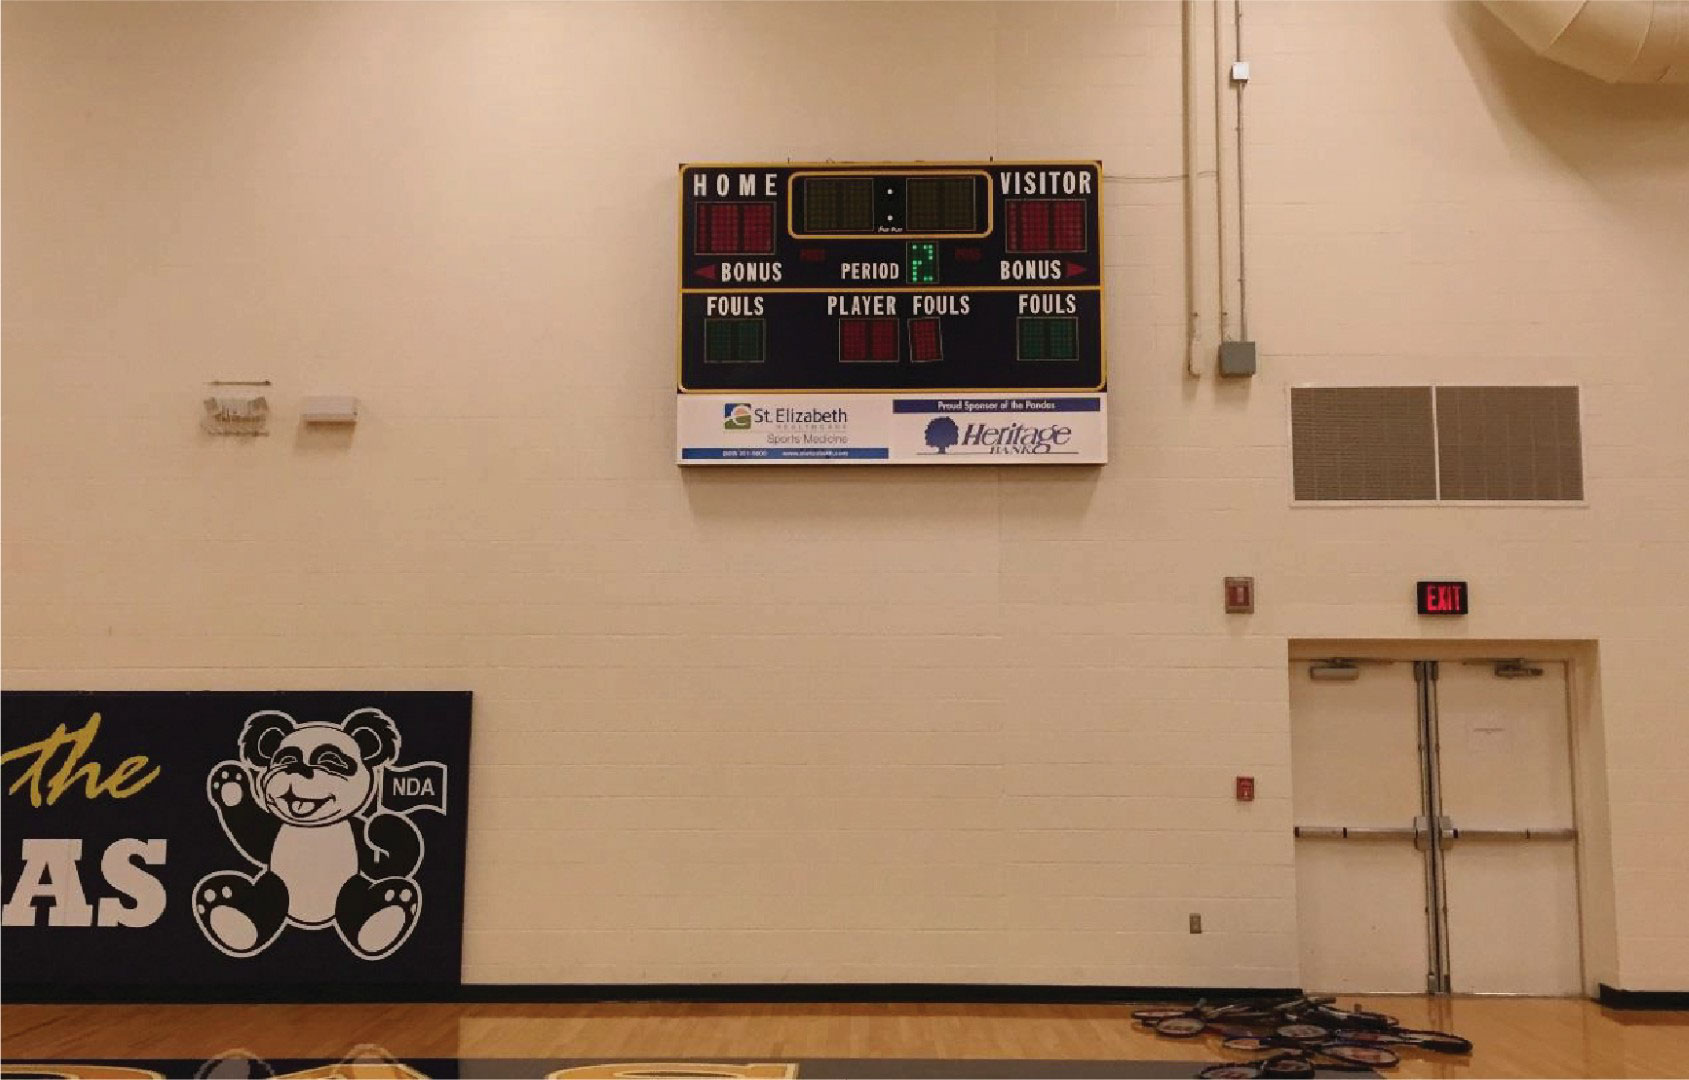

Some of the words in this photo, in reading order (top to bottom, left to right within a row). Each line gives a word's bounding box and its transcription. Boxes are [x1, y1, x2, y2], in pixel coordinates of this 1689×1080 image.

[694, 173, 778, 197] HOME
[1000, 171, 1091, 195] VISITOR
[721, 263, 783, 282] BONUS
[840, 263, 899, 280] PERIOD
[1000, 260, 1061, 280] BONUS
[706, 296, 764, 316] FOULS
[827, 295, 896, 316] PLAYER
[912, 295, 970, 316] FOULS
[1018, 294, 1076, 314] FOULS
[776, 408, 847, 423] Elizabeth
[938, 401, 962, 409] Proud
[964, 401, 998, 411] Sponsor
[1000, 400, 1008, 409] of
[1011, 400, 1023, 409] the
[1026, 400, 1055, 409] Pandas
[767, 433, 800, 445] Sports
[804, 433, 848, 444] Medicine
[962, 422, 1071, 454] Heritage
[1427, 584, 1461, 610] EXIT
[1, 712, 160, 808] the
[393, 776, 435, 796] NDA
